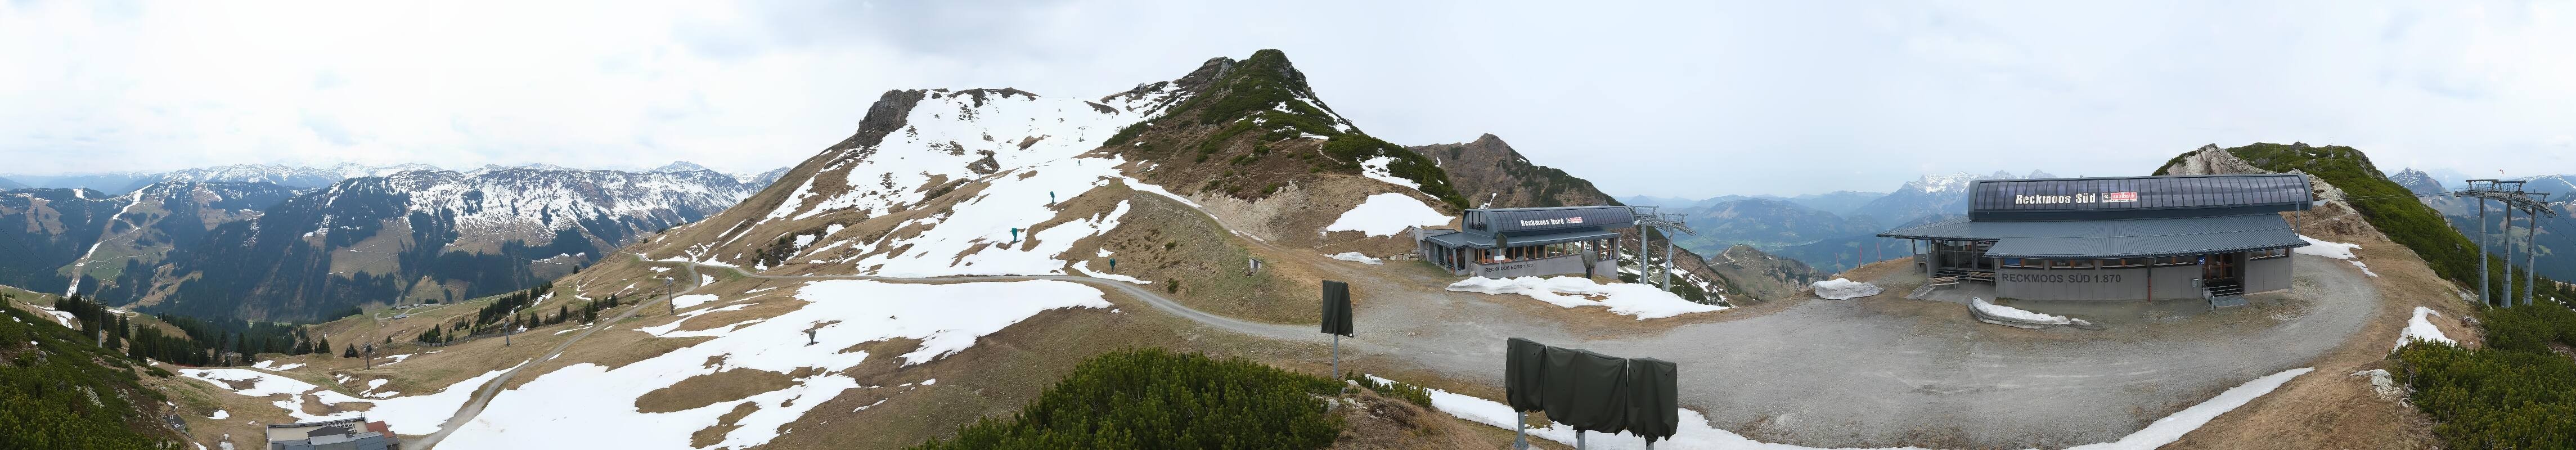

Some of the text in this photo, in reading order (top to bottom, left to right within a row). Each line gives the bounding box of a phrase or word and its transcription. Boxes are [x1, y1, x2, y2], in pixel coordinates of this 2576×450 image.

[2016, 193, 2096, 204] Reckmoos Süd
[2002, 273, 2121, 283] RECKMOOS SÜD 1.870
